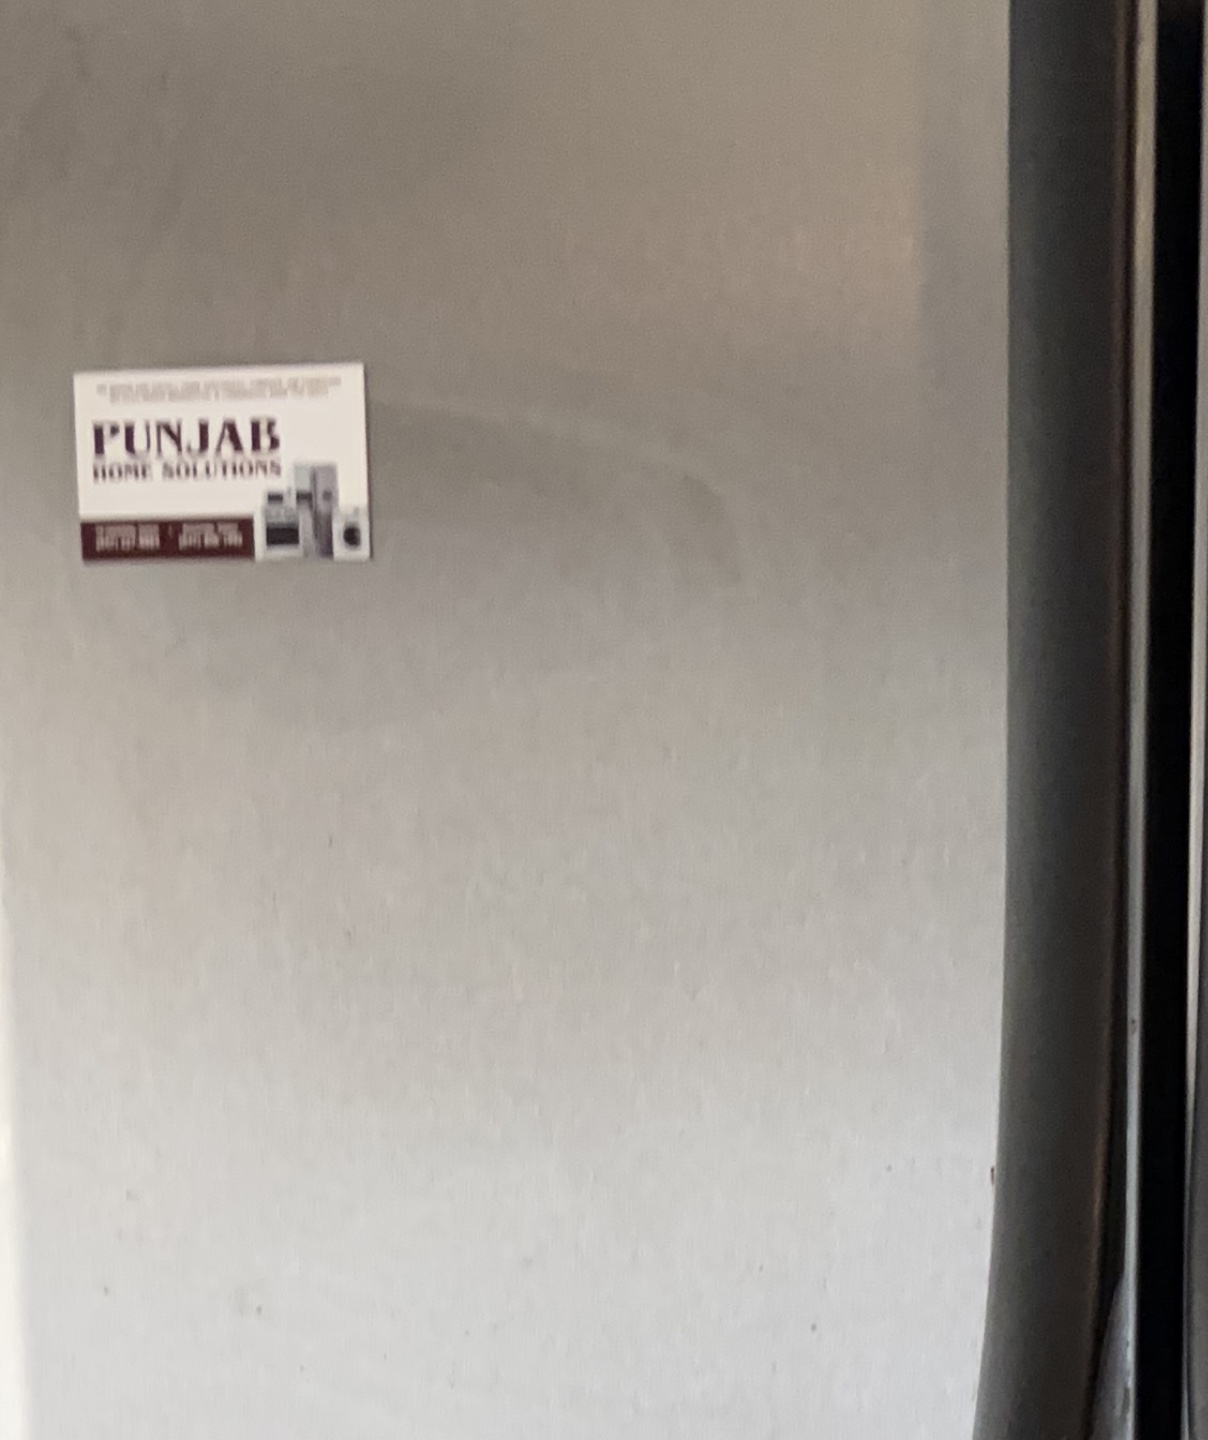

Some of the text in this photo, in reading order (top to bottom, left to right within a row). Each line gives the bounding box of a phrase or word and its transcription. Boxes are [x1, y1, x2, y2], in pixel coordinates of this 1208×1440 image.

[93, 417, 280, 457] PUNJAB
[93, 460, 282, 483] HOME SOLUTIONS
